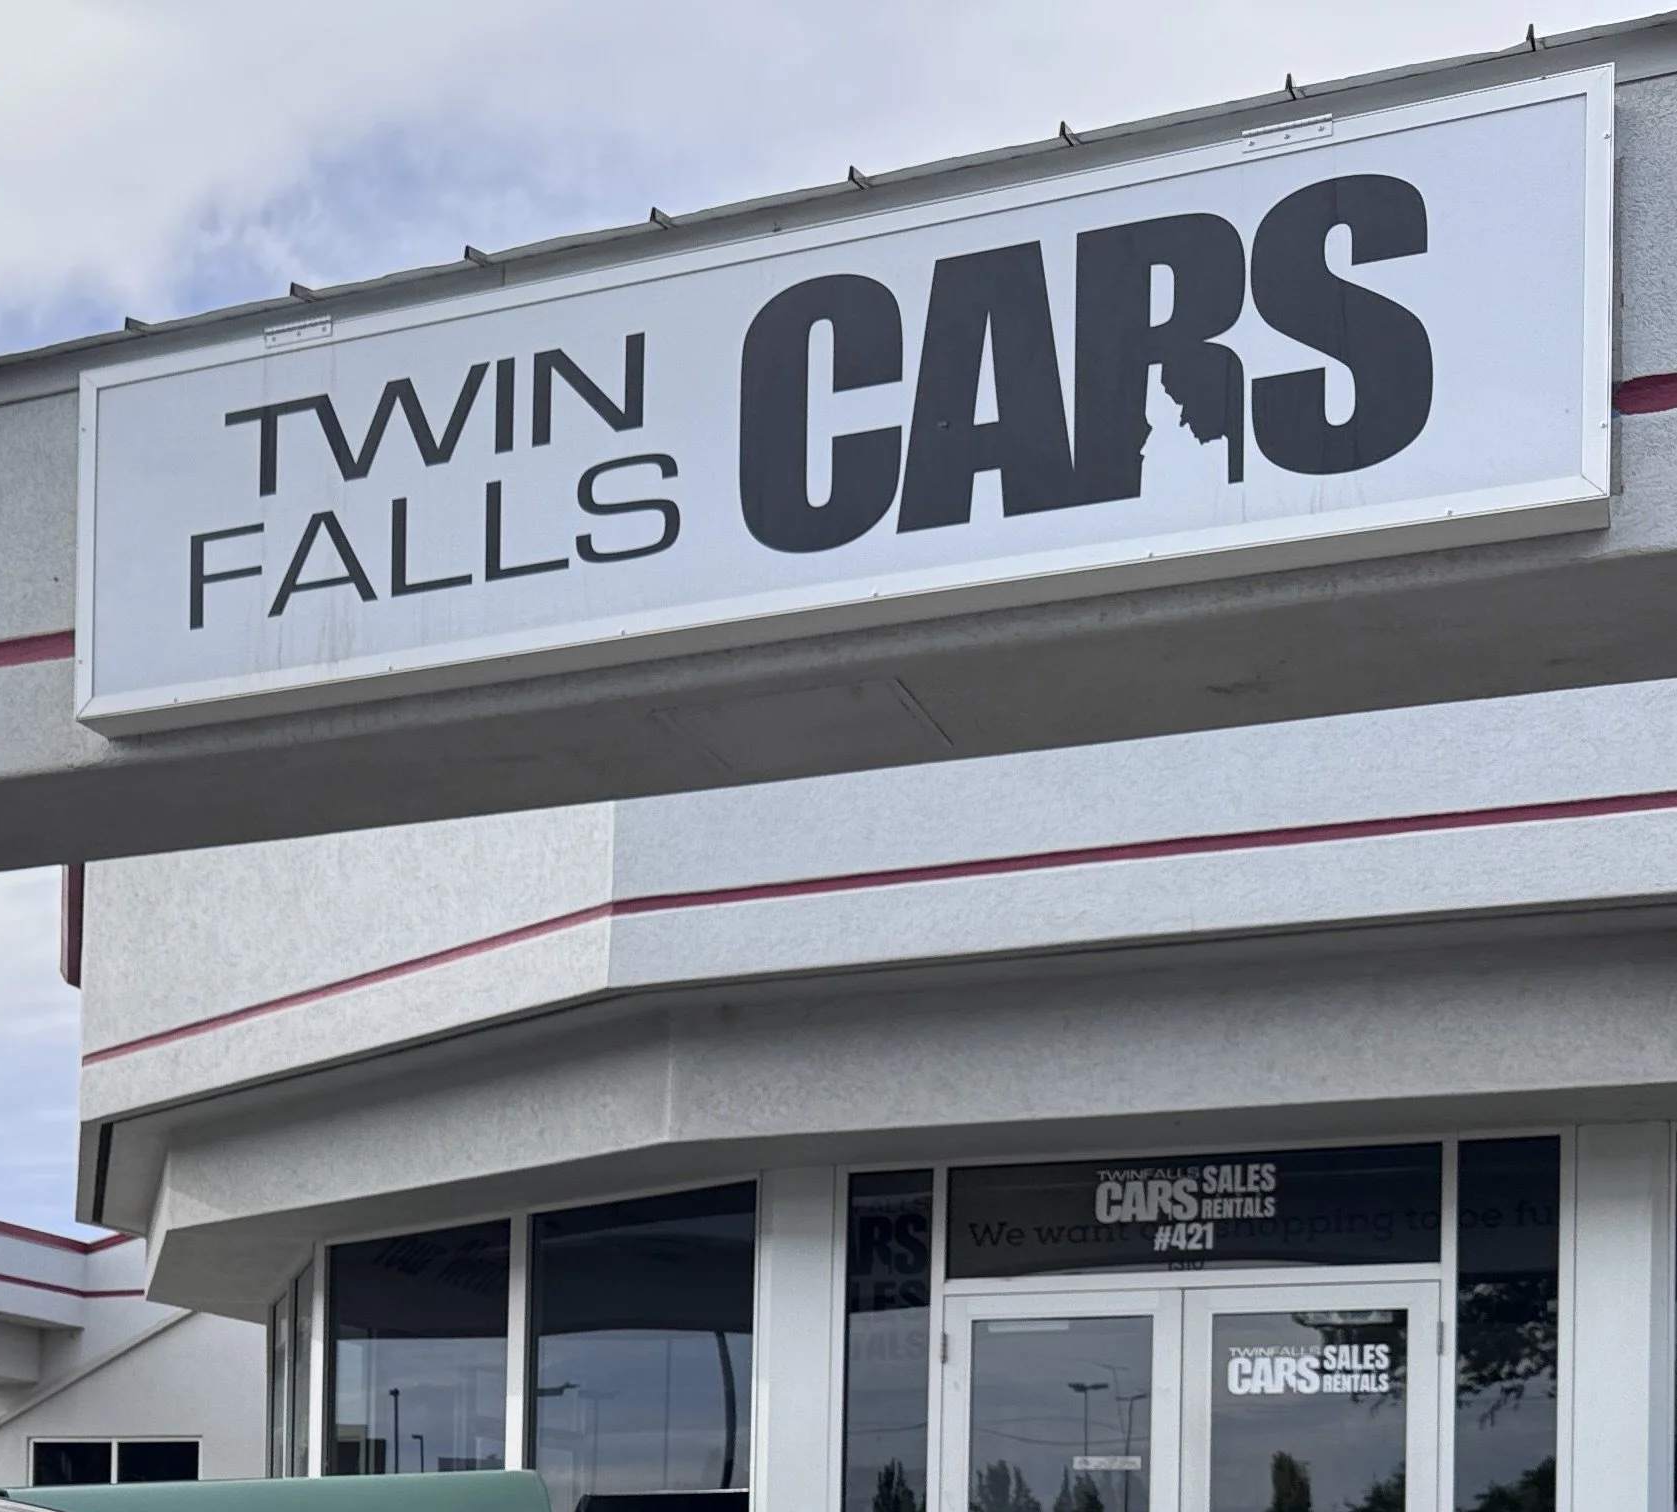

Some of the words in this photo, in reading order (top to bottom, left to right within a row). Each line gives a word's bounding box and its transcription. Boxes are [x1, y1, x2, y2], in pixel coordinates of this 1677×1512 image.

[740, 174, 1433, 553] CARS
[225, 333, 644, 496] TWIN
[190, 454, 680, 629] FALLS
[1201, 1163, 1276, 1194] SALES
[1094, 1179, 1199, 1224] CARS
[1201, 1196, 1276, 1220] RENTALS
[968, 1221, 1024, 1247] We
[1033, 1222, 1130, 1245] want
[1153, 1222, 1213, 1251] #421
[1323, 1344, 1390, 1370] SALES
[1227, 1355, 1321, 1395] CARS
[1322, 1372, 1390, 1393] RENTALS
